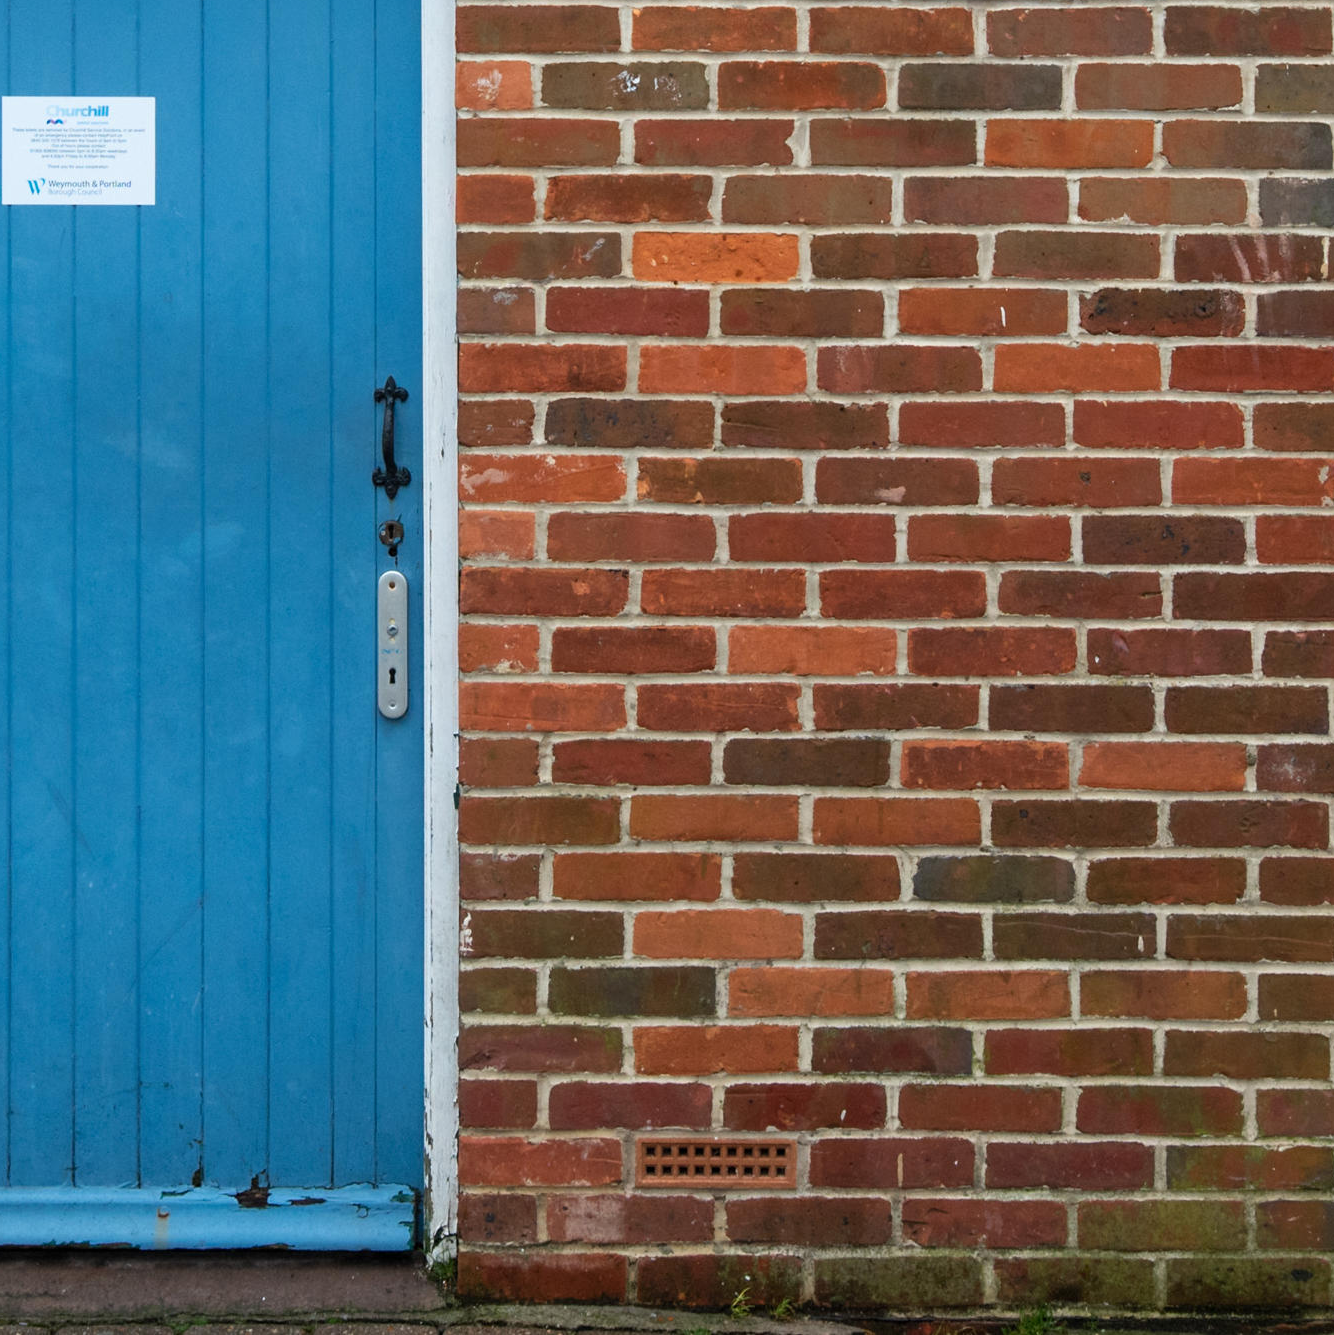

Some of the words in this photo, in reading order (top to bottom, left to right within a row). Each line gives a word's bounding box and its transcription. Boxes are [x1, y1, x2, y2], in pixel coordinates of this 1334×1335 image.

[46, 105, 109, 117] Churchill
[48, 179, 90, 188] Weymouth
[91, 180, 98, 188] &
[99, 179, 132, 188] Portland
[48, 188, 76, 196] Borough
[77, 188, 103, 196] Council
